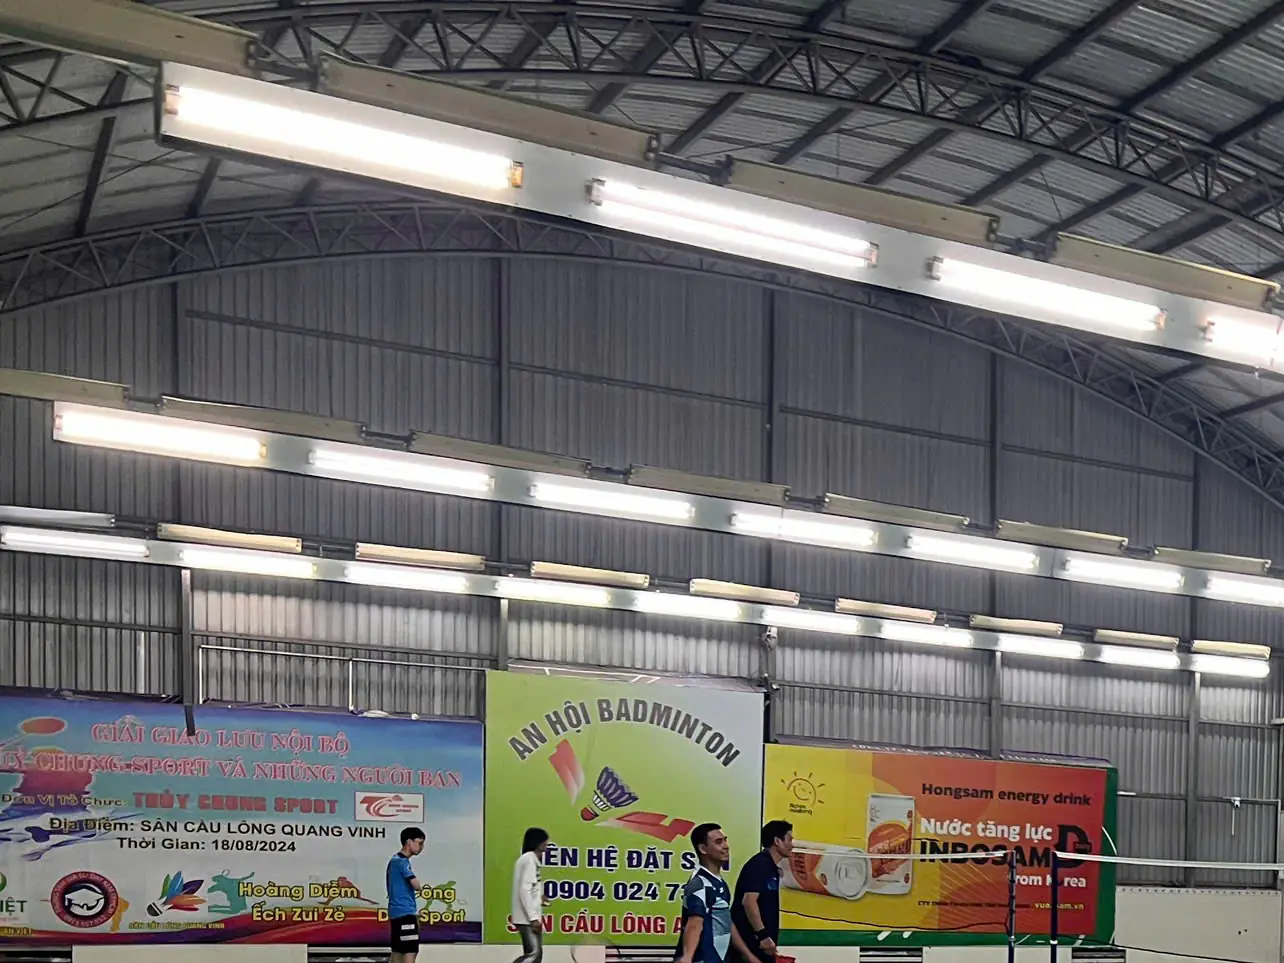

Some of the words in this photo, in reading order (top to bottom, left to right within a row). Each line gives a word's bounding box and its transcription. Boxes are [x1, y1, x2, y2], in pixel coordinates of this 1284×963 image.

[152, 726, 212, 748] GIAO
[216, 728, 266, 749] LƯU
[271, 728, 314, 756] NỘI
[318, 731, 351, 758] BỘ
[509, 722, 548, 761] AN
[545, 701, 591, 735] HỘI
[596, 698, 741, 768] BADMINTON
[418, 768, 462, 790] BẠN
[273, 796, 340, 815] SPORT
[921, 783, 994, 800] Hongsam
[997, 789, 1050, 806] energy
[1053, 792, 1092, 806] drink
[49, 817, 79, 834] Địa
[140, 817, 178, 833] SÂN
[281, 823, 343, 838] QUANG
[348, 825, 386, 839] VINH
[920, 817, 972, 836] Nước
[976, 820, 1020, 842] tăng
[1025, 823, 1053, 844] lực
[116, 836, 156, 850] Thời
[161, 837, 205, 850] Gian:
[211, 839, 297, 853] 18/08/2024
[586, 845, 619, 873] HỆ
[627, 846, 674, 873] ĐẶT
[238, 881, 304, 900] Hoàng
[543, 880, 605, 900] 0904
[613, 881, 660, 901] 024
[1008, 873, 1042, 887] rom
[252, 901, 287, 922] Ếch
[291, 906, 318, 922] Zui
[419, 908, 467, 925] Sport
[611, 912, 666, 934] LÔNG
